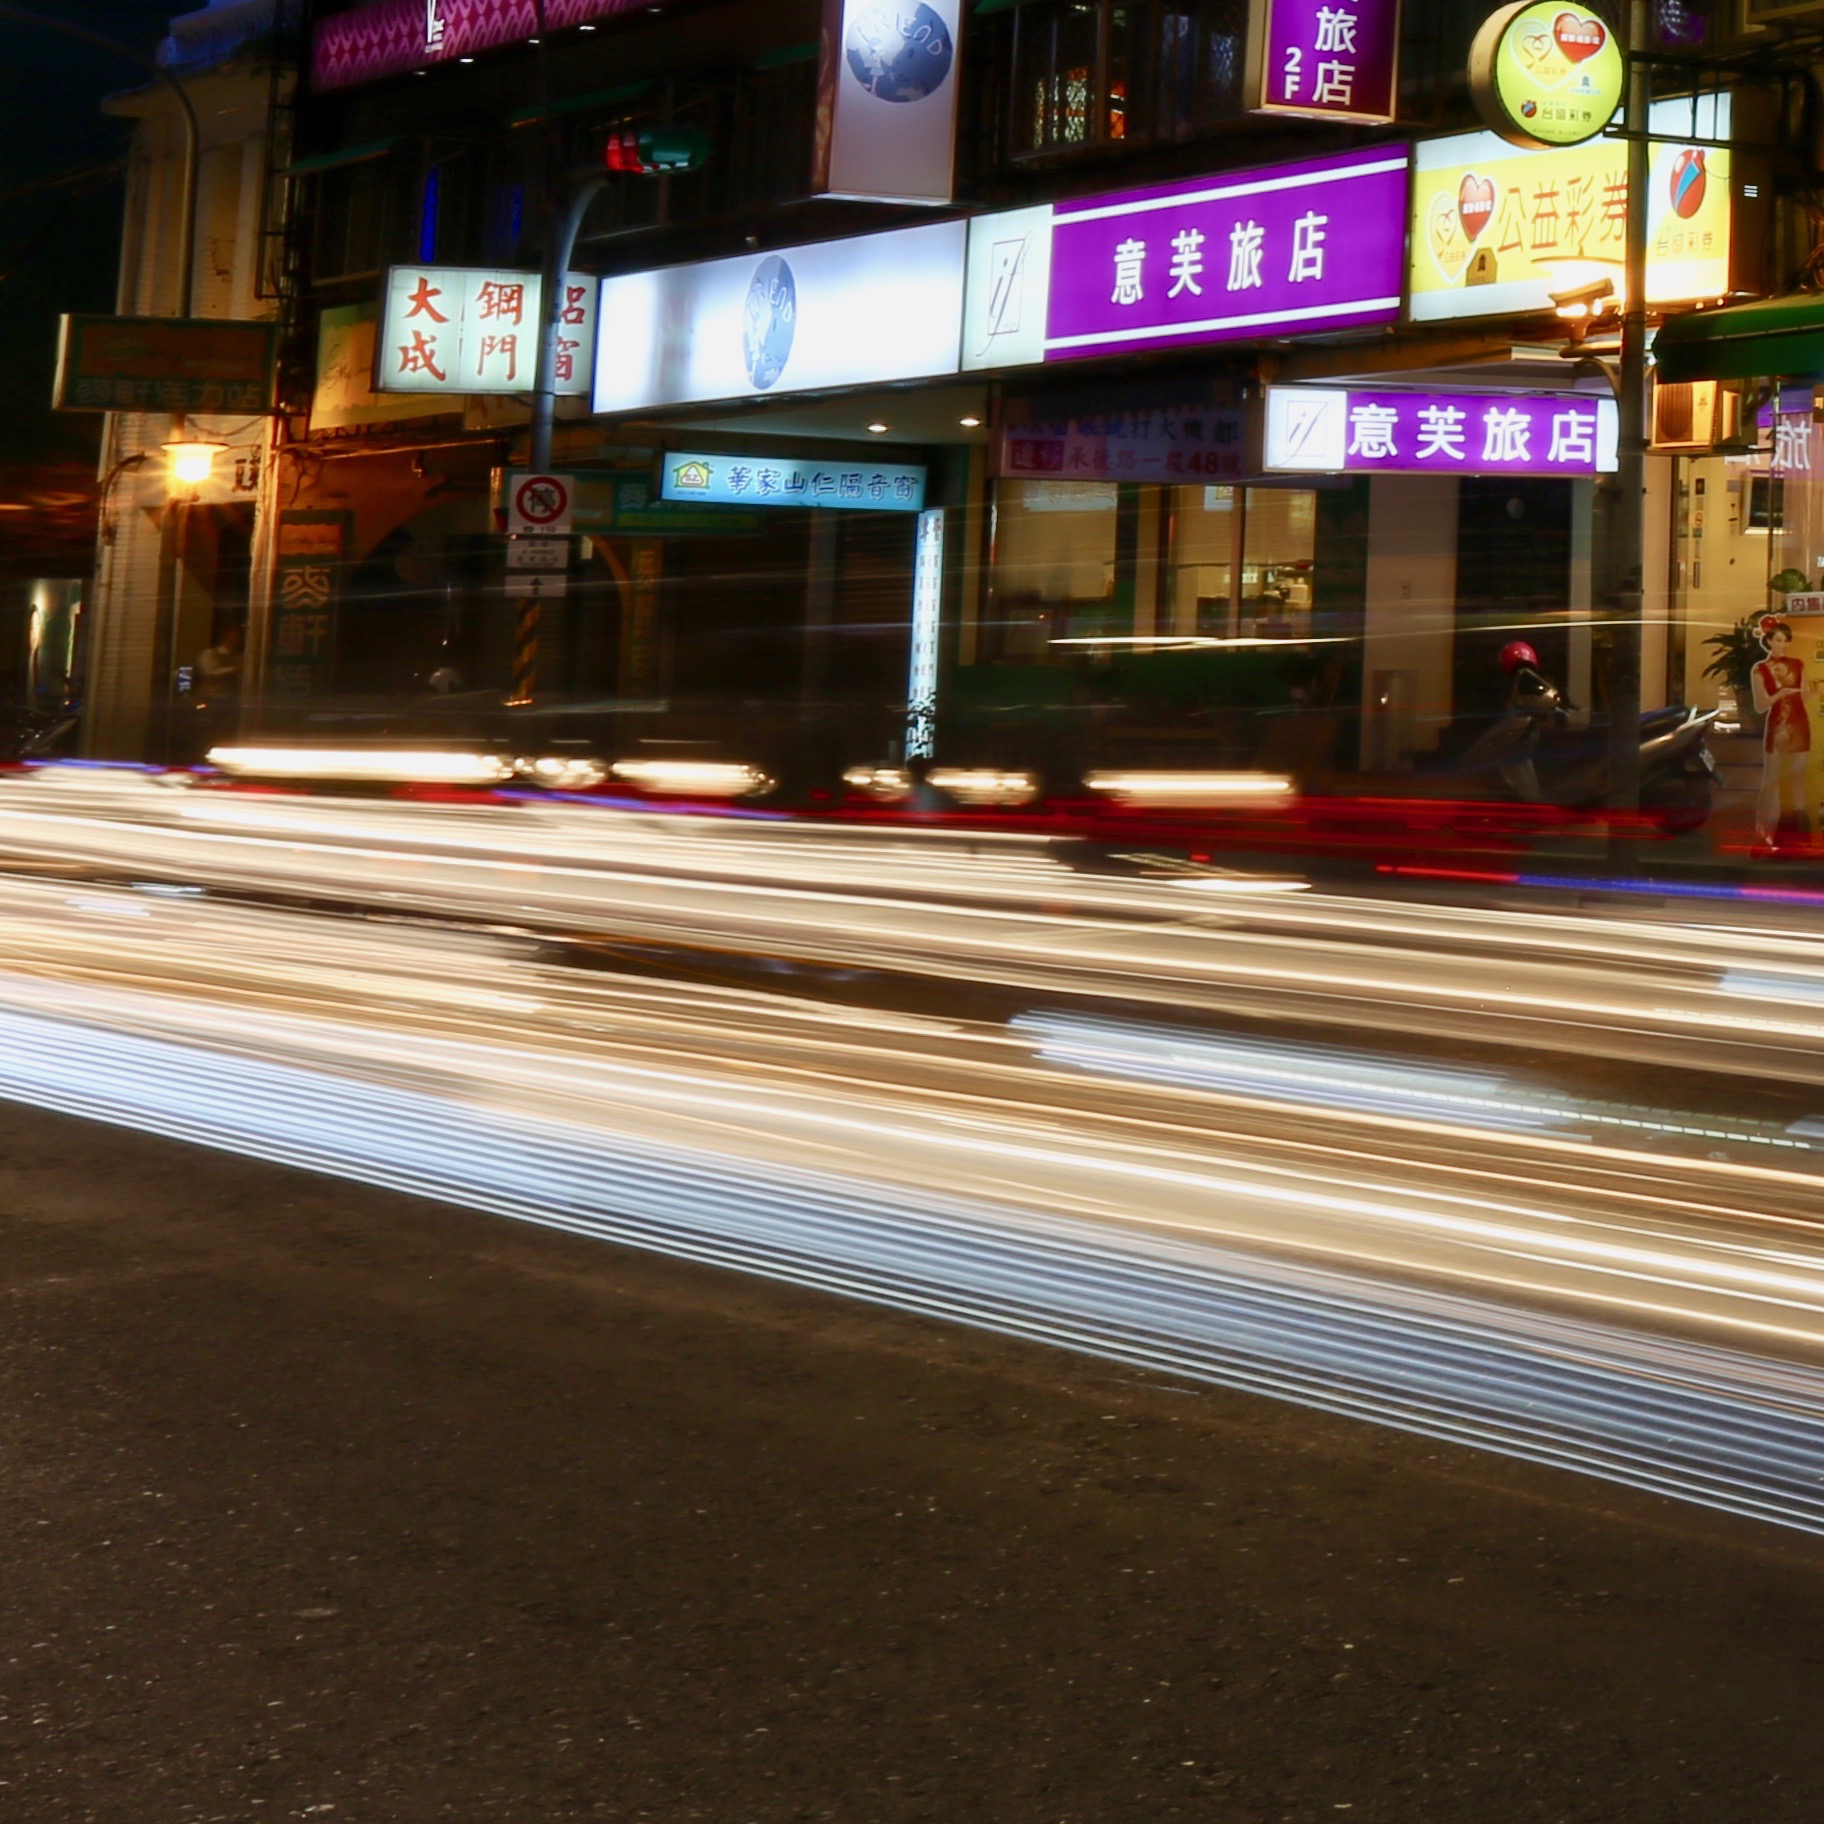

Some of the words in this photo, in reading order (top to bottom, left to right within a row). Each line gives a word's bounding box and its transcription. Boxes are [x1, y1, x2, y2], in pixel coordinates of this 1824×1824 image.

[1497, 169, 1629, 253] 公益彩券
[1109, 209, 1331, 307] 意芙旅店
[396, 276, 450, 382] 大成
[1347, 402, 1597, 465] 意芙旅店
